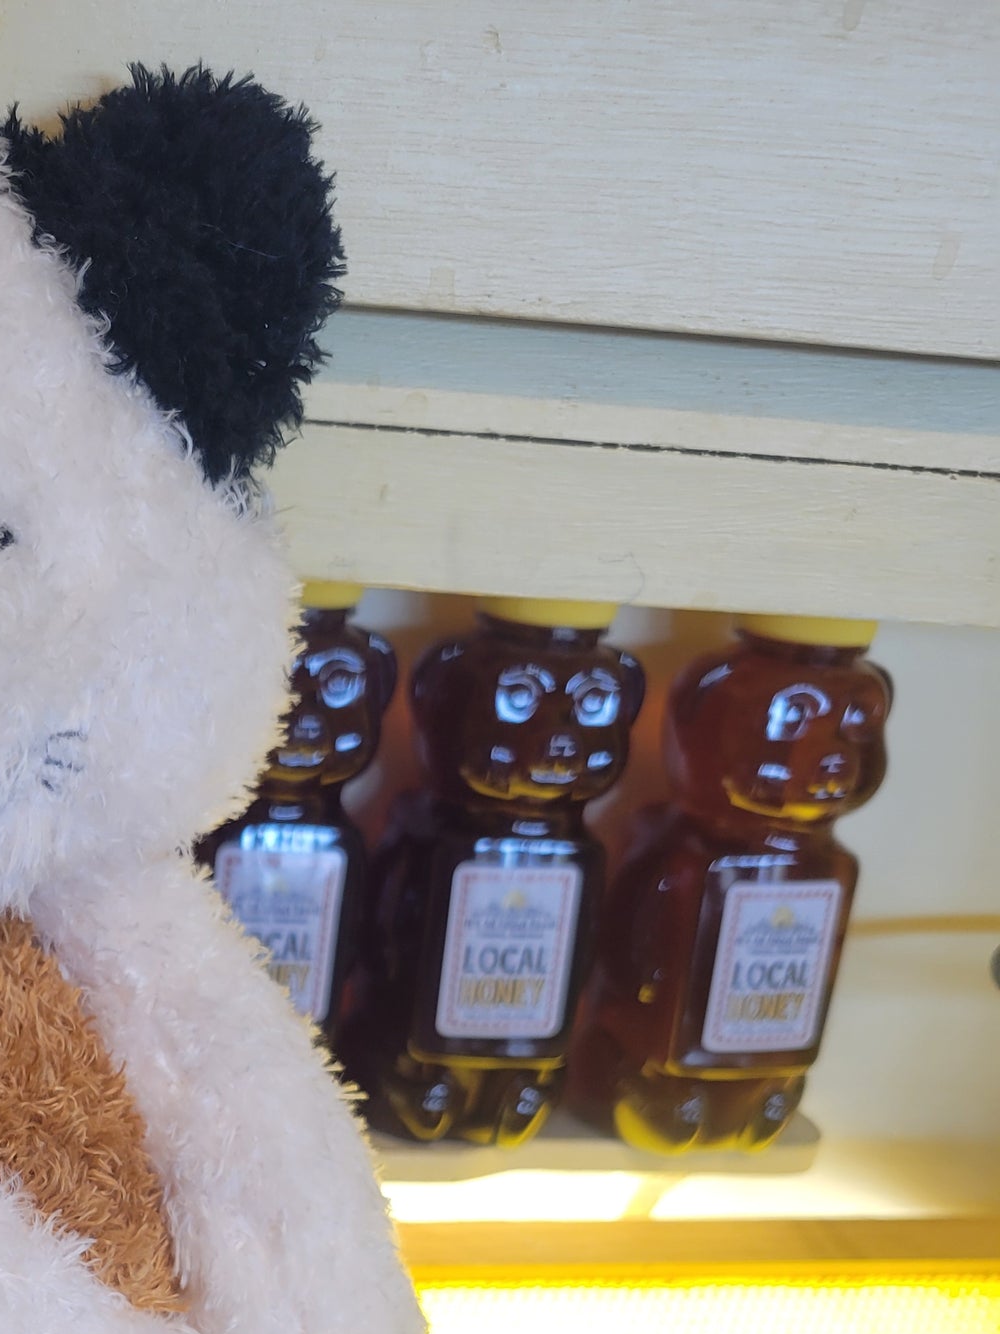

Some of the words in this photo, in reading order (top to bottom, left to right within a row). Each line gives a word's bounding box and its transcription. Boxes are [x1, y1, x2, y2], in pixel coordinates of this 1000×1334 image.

[462, 945, 547, 975] LOCAL
[731, 960, 807, 990] LOCAL
[459, 975, 546, 1009] HONEY
